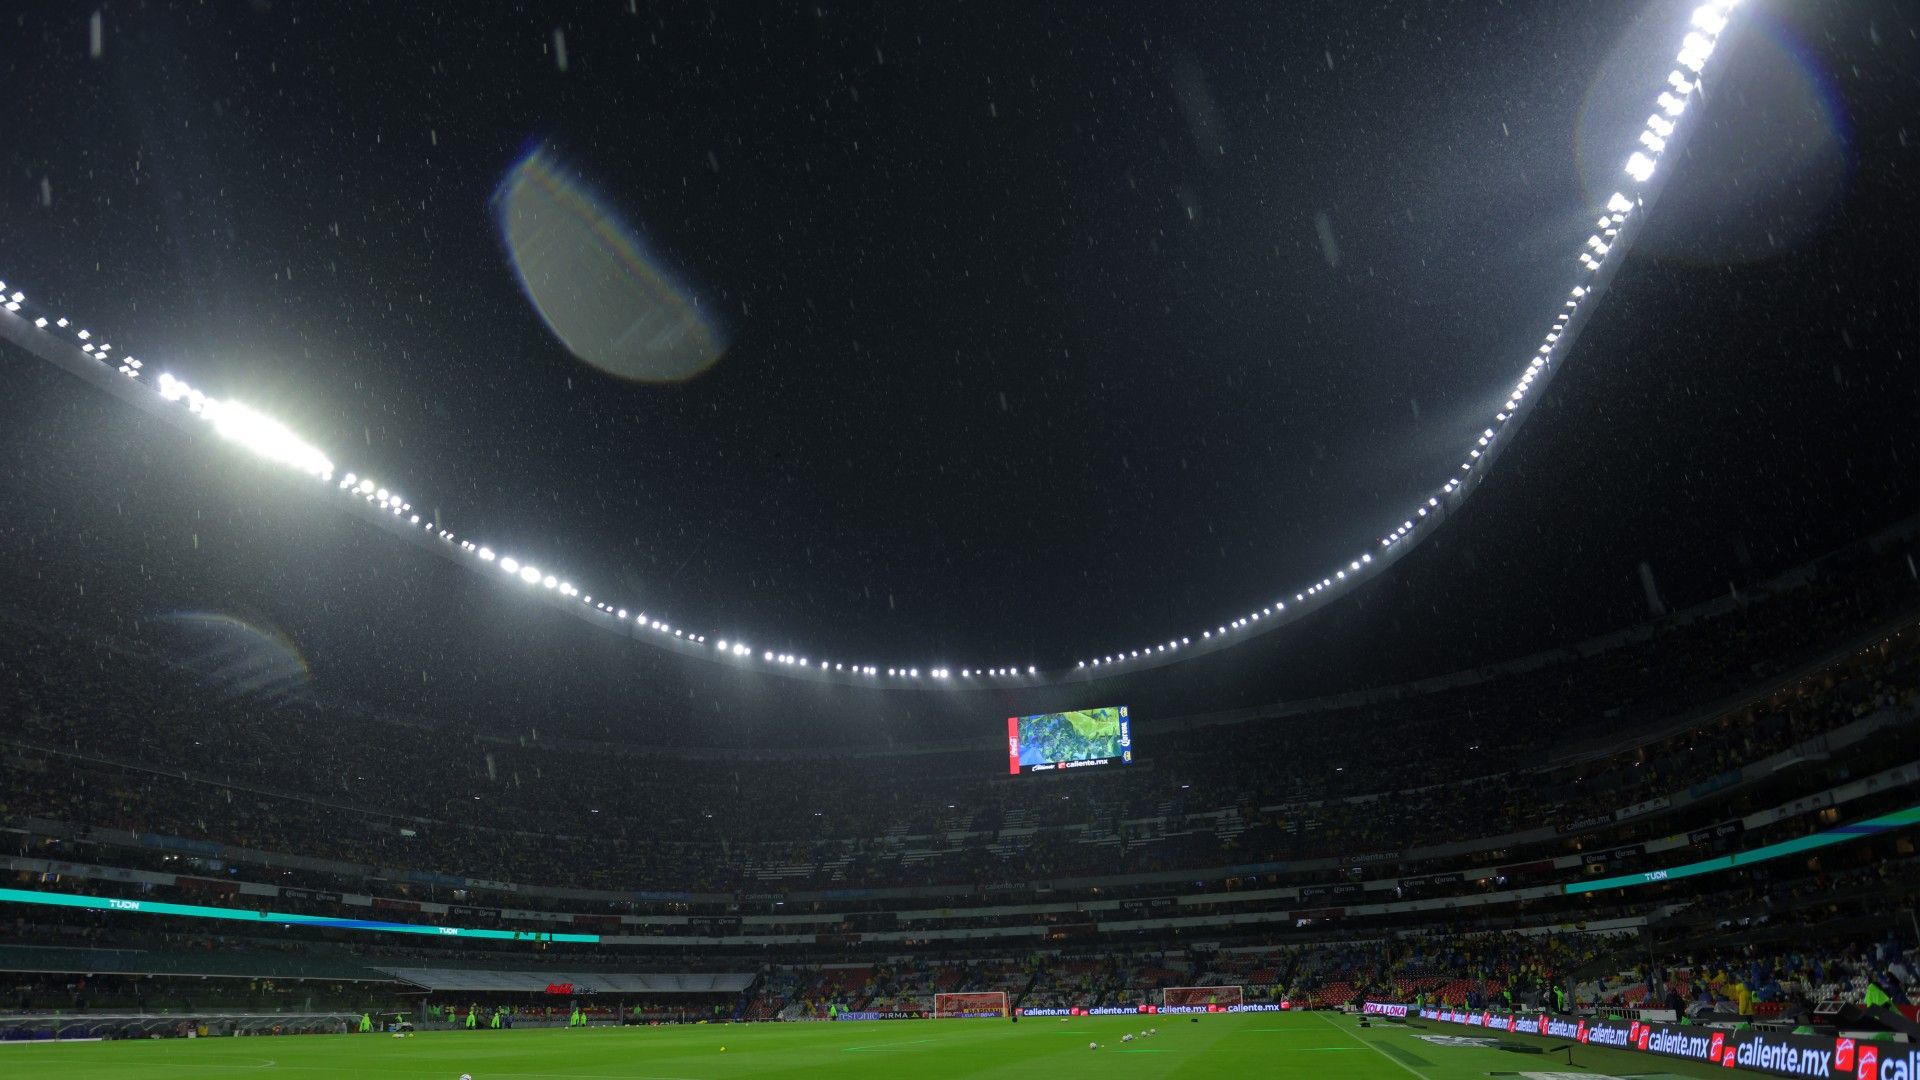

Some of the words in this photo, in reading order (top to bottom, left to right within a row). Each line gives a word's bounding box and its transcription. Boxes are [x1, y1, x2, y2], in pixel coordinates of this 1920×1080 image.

[1065, 759, 1109, 768] caliente.mx
[1644, 870, 1668, 881] TUDN
[109, 899, 140, 910] TUDN
[1023, 1008, 1070, 1016] caliente.mx
[1089, 1007, 1137, 1015] caliente.mx
[1157, 1005, 1207, 1014] caliente.mx
[1227, 1003, 1280, 1012] caliente.mx
[1364, 1003, 1384, 1013] KOLA
[1385, 1005, 1405, 1016] LOKA
[1548, 1018, 1578, 1038] caliente.mx
[1589, 1023, 1629, 1046] caliente.mx
[1648, 1028, 1710, 1058] caliente.mx
[1737, 1036, 1832, 1077] caliente.mx
